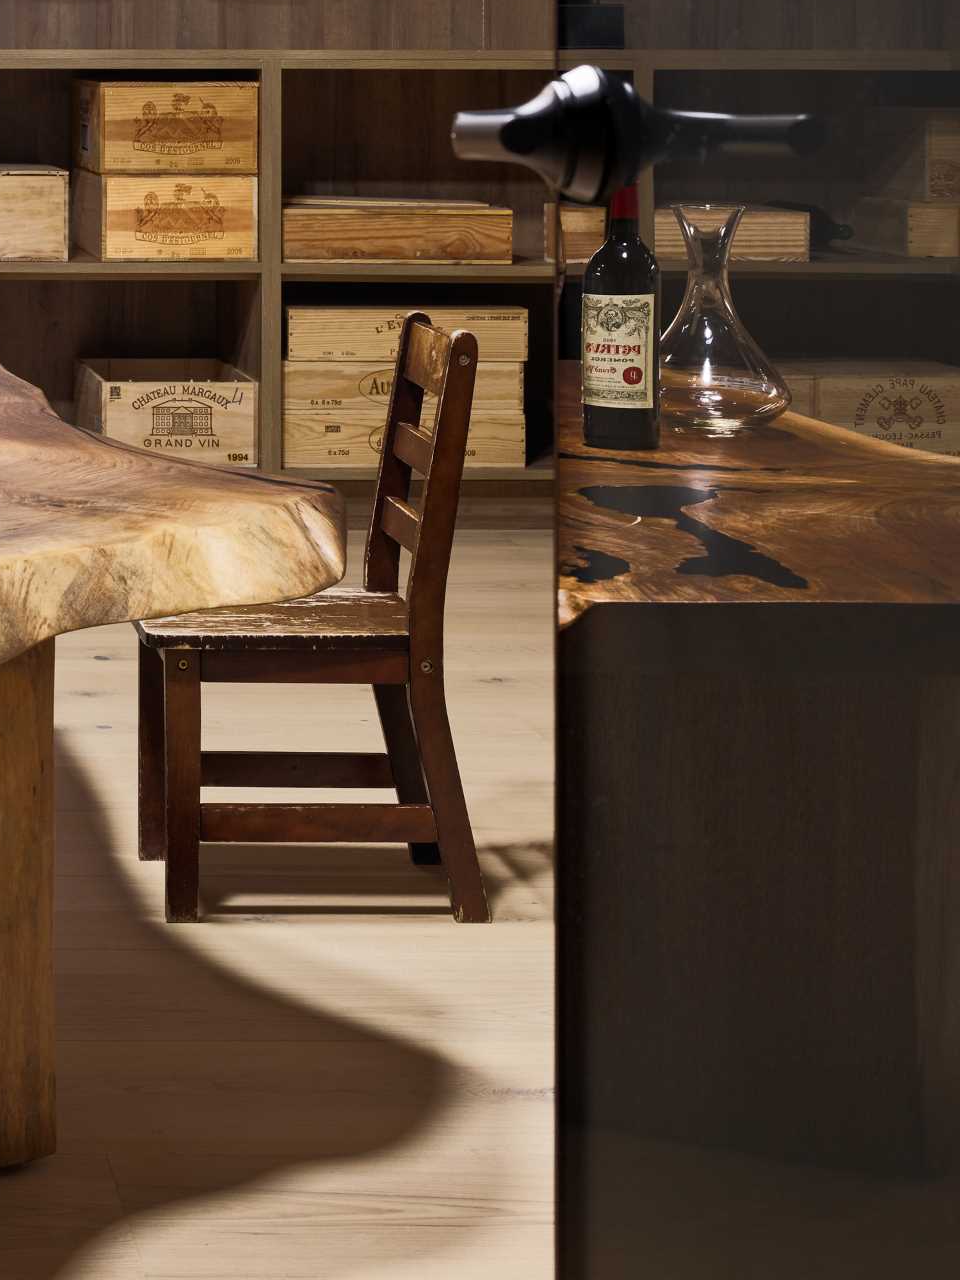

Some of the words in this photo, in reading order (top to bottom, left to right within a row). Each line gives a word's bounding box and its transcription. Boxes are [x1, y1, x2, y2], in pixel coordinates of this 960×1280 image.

[182, 385, 230, 410] MARGAUX
[143, 439, 193, 448] GRAND
[198, 439, 220, 448] VIN
[227, 453, 249, 462] 1994
